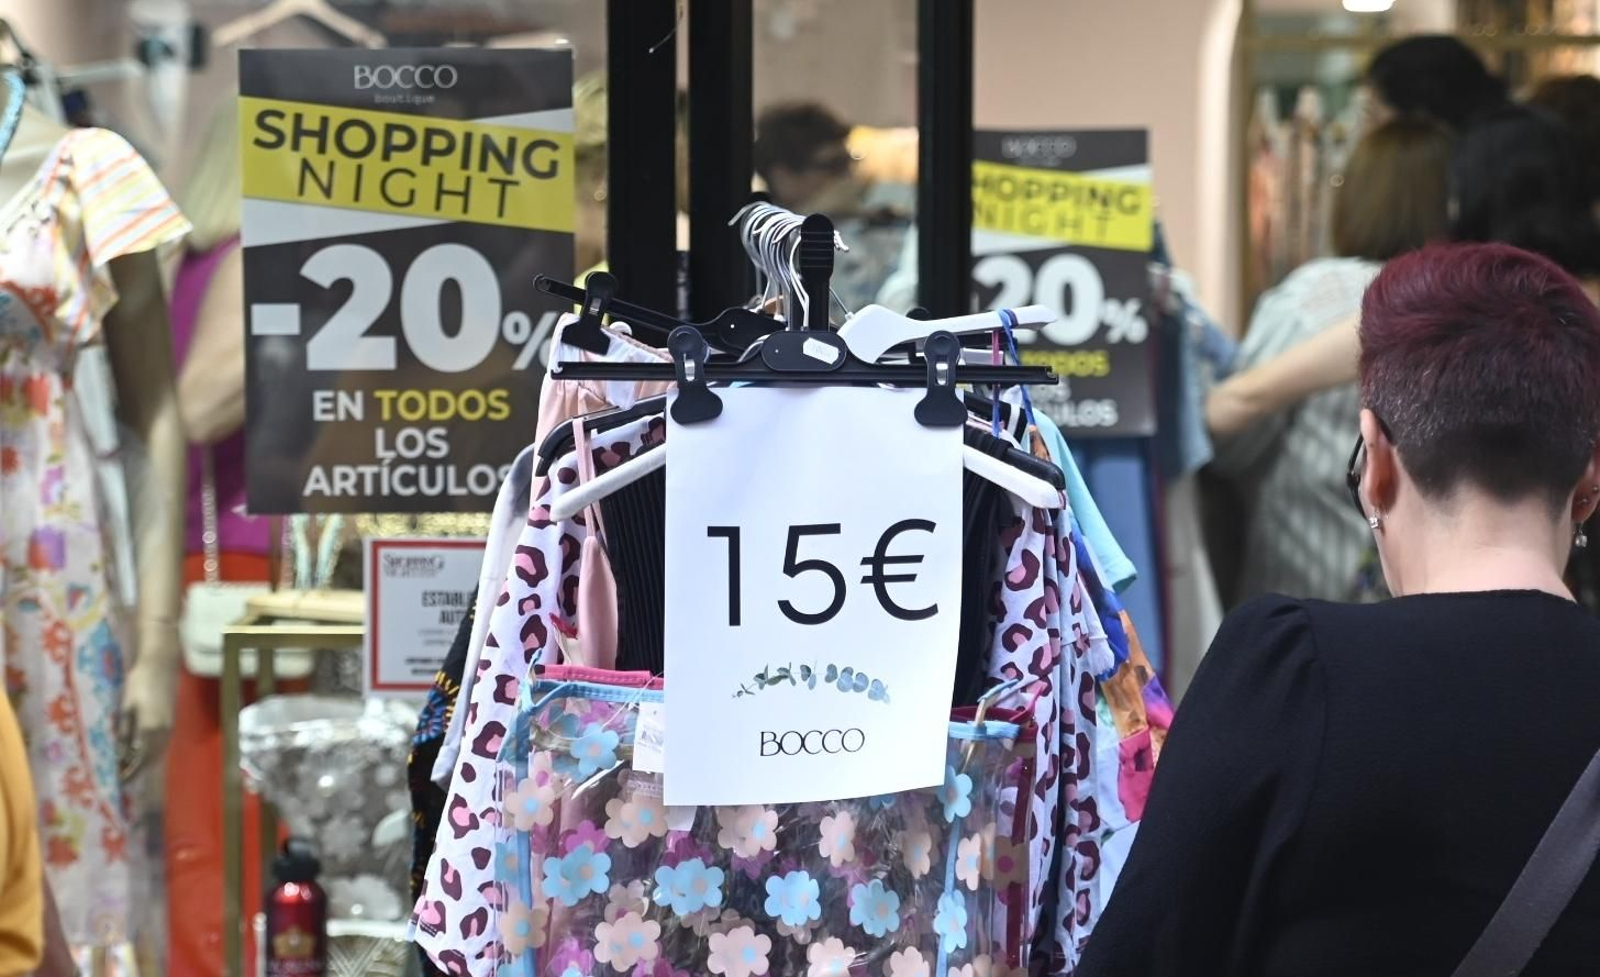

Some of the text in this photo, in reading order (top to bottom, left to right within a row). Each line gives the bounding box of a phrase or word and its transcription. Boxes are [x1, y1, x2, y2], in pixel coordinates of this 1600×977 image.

[353, 64, 458, 90] BOCCO
[373, 92, 435, 105] boutique
[253, 109, 560, 179] SHOPPING
[297, 157, 520, 218] NIGHT
[971, 173, 1141, 215] HOPPING
[250, 242, 559, 373] -20%
[312, 389, 511, 422] EN TODOS
[375, 427, 450, 460] LOS
[707, 518, 939, 627] 15€
[422, 591, 470, 607] ESTABL
[440, 610, 465, 624] AUT
[760, 727, 866, 757] BOCCO
